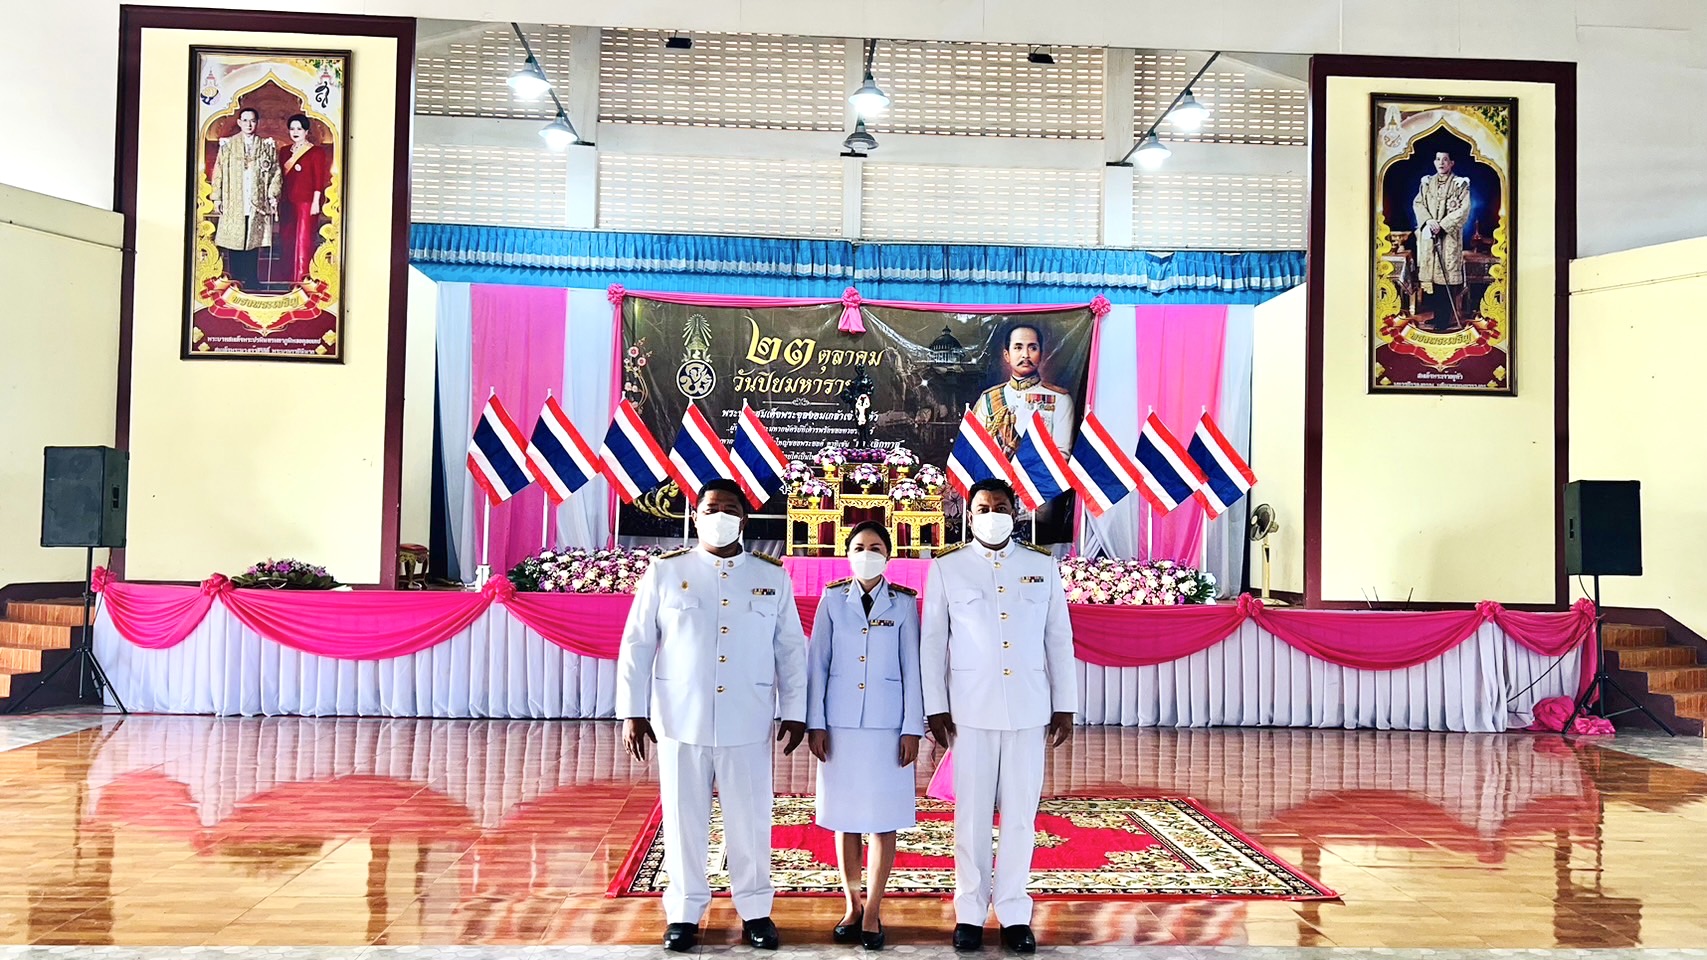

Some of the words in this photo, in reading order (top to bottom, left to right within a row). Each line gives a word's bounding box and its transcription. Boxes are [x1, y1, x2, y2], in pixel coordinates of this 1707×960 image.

[743, 315, 817, 374] ๒๓
[817, 349, 885, 374] ตุลาคม
